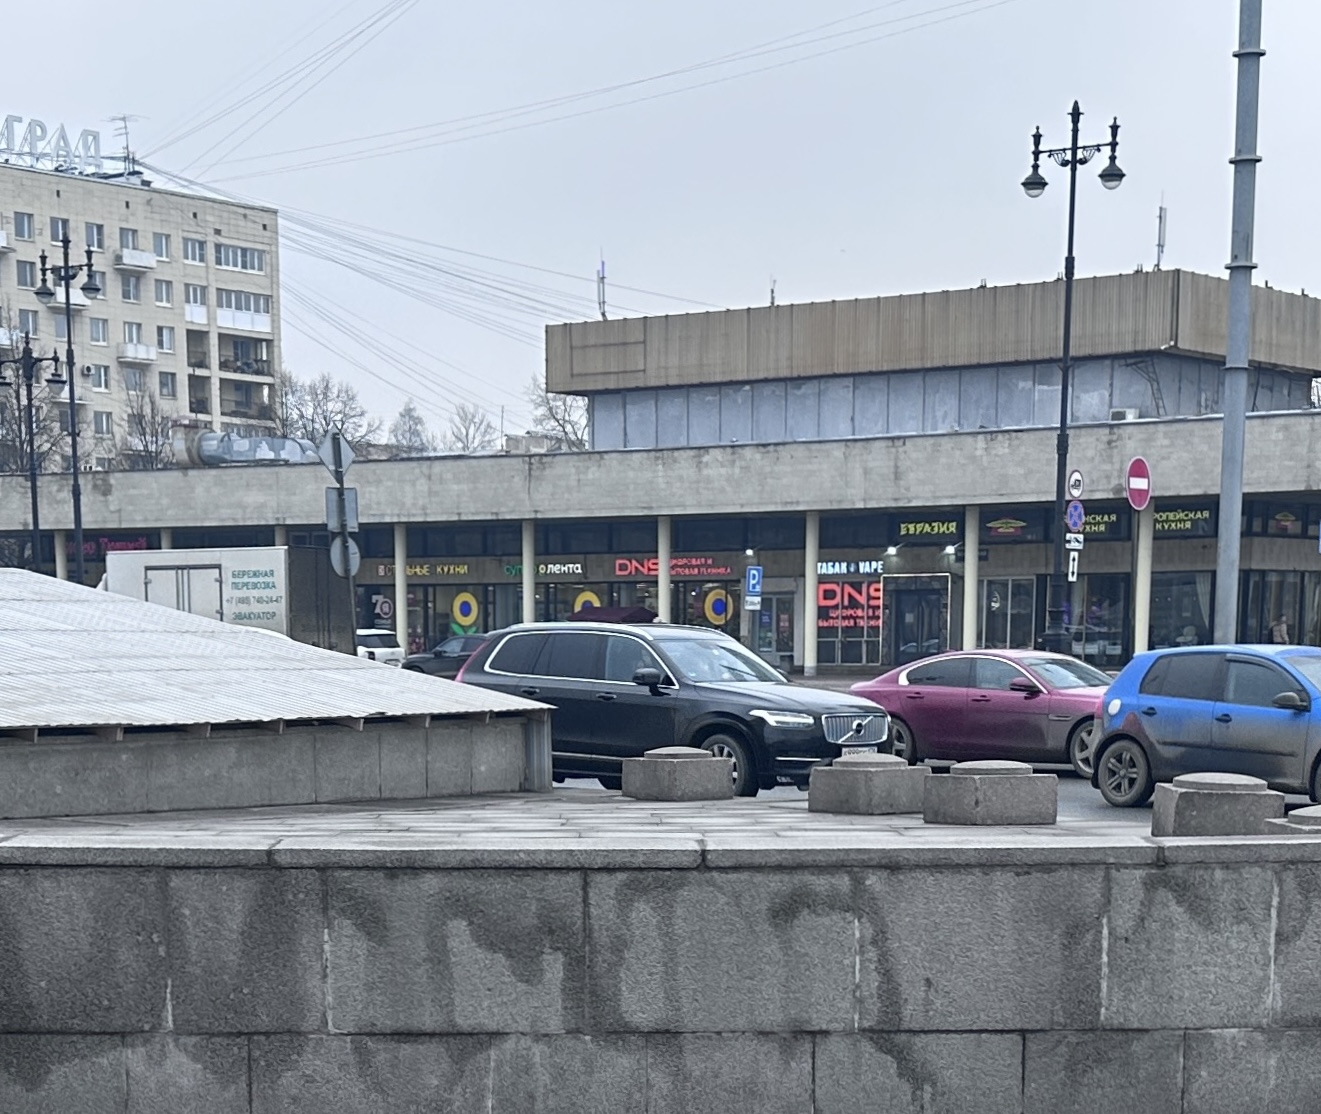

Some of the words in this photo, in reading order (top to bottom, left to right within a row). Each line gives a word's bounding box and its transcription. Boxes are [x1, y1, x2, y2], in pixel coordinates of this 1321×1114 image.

[1153, 509, 1210, 521] РОПЕЙСКАЯ
[899, 521, 957, 535] ЕВРАЗИЯ
[1079, 523, 1106, 532] УХНЯ
[1156, 520, 1192, 530] КУХНЯ
[436, 564, 468, 575] КУХНИ
[546, 563, 583, 574] лента
[615, 558, 659, 576] DNS
[817, 562, 847, 574] ТАБАК
[858, 560, 883, 574] VAPE
[231, 569, 275, 579] БЕРЕЖНАЯ
[231, 581, 277, 590] ПЕРЕВОЗКА
[749, 569, 759, 591] P
[817, 583, 881, 606] DNS
[231, 611, 276, 620] ЭВАКУАТОР
